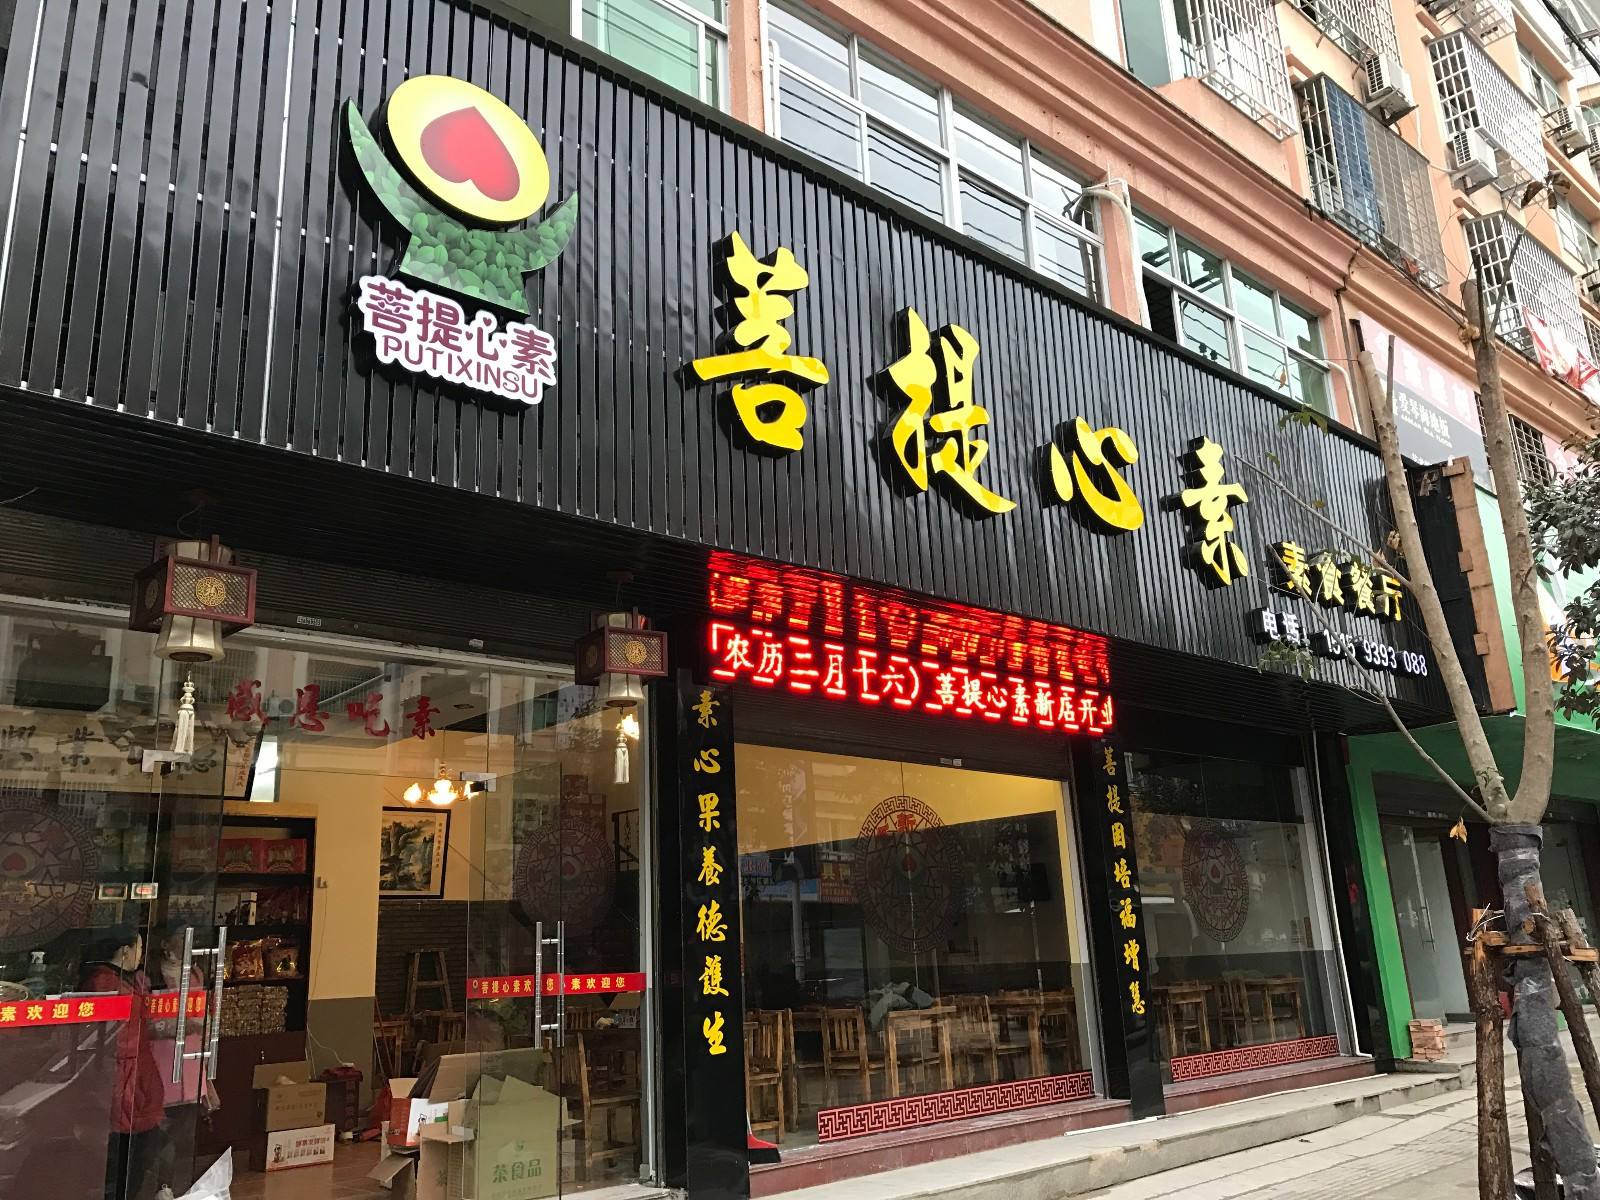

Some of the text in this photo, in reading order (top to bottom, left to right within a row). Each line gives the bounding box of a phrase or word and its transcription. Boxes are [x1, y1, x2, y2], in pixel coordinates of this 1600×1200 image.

[366, 282, 552, 379] 菩提心素
[383, 335, 538, 398] PUTIXINSU
[692, 231, 1249, 586] 菩提心素
[1363, 640, 1397, 669] 9393
[1403, 651, 1428, 677] 088
[481, 977, 554, 995] 菩提心素欢您
[492, 1158, 542, 1184] 茶食品
